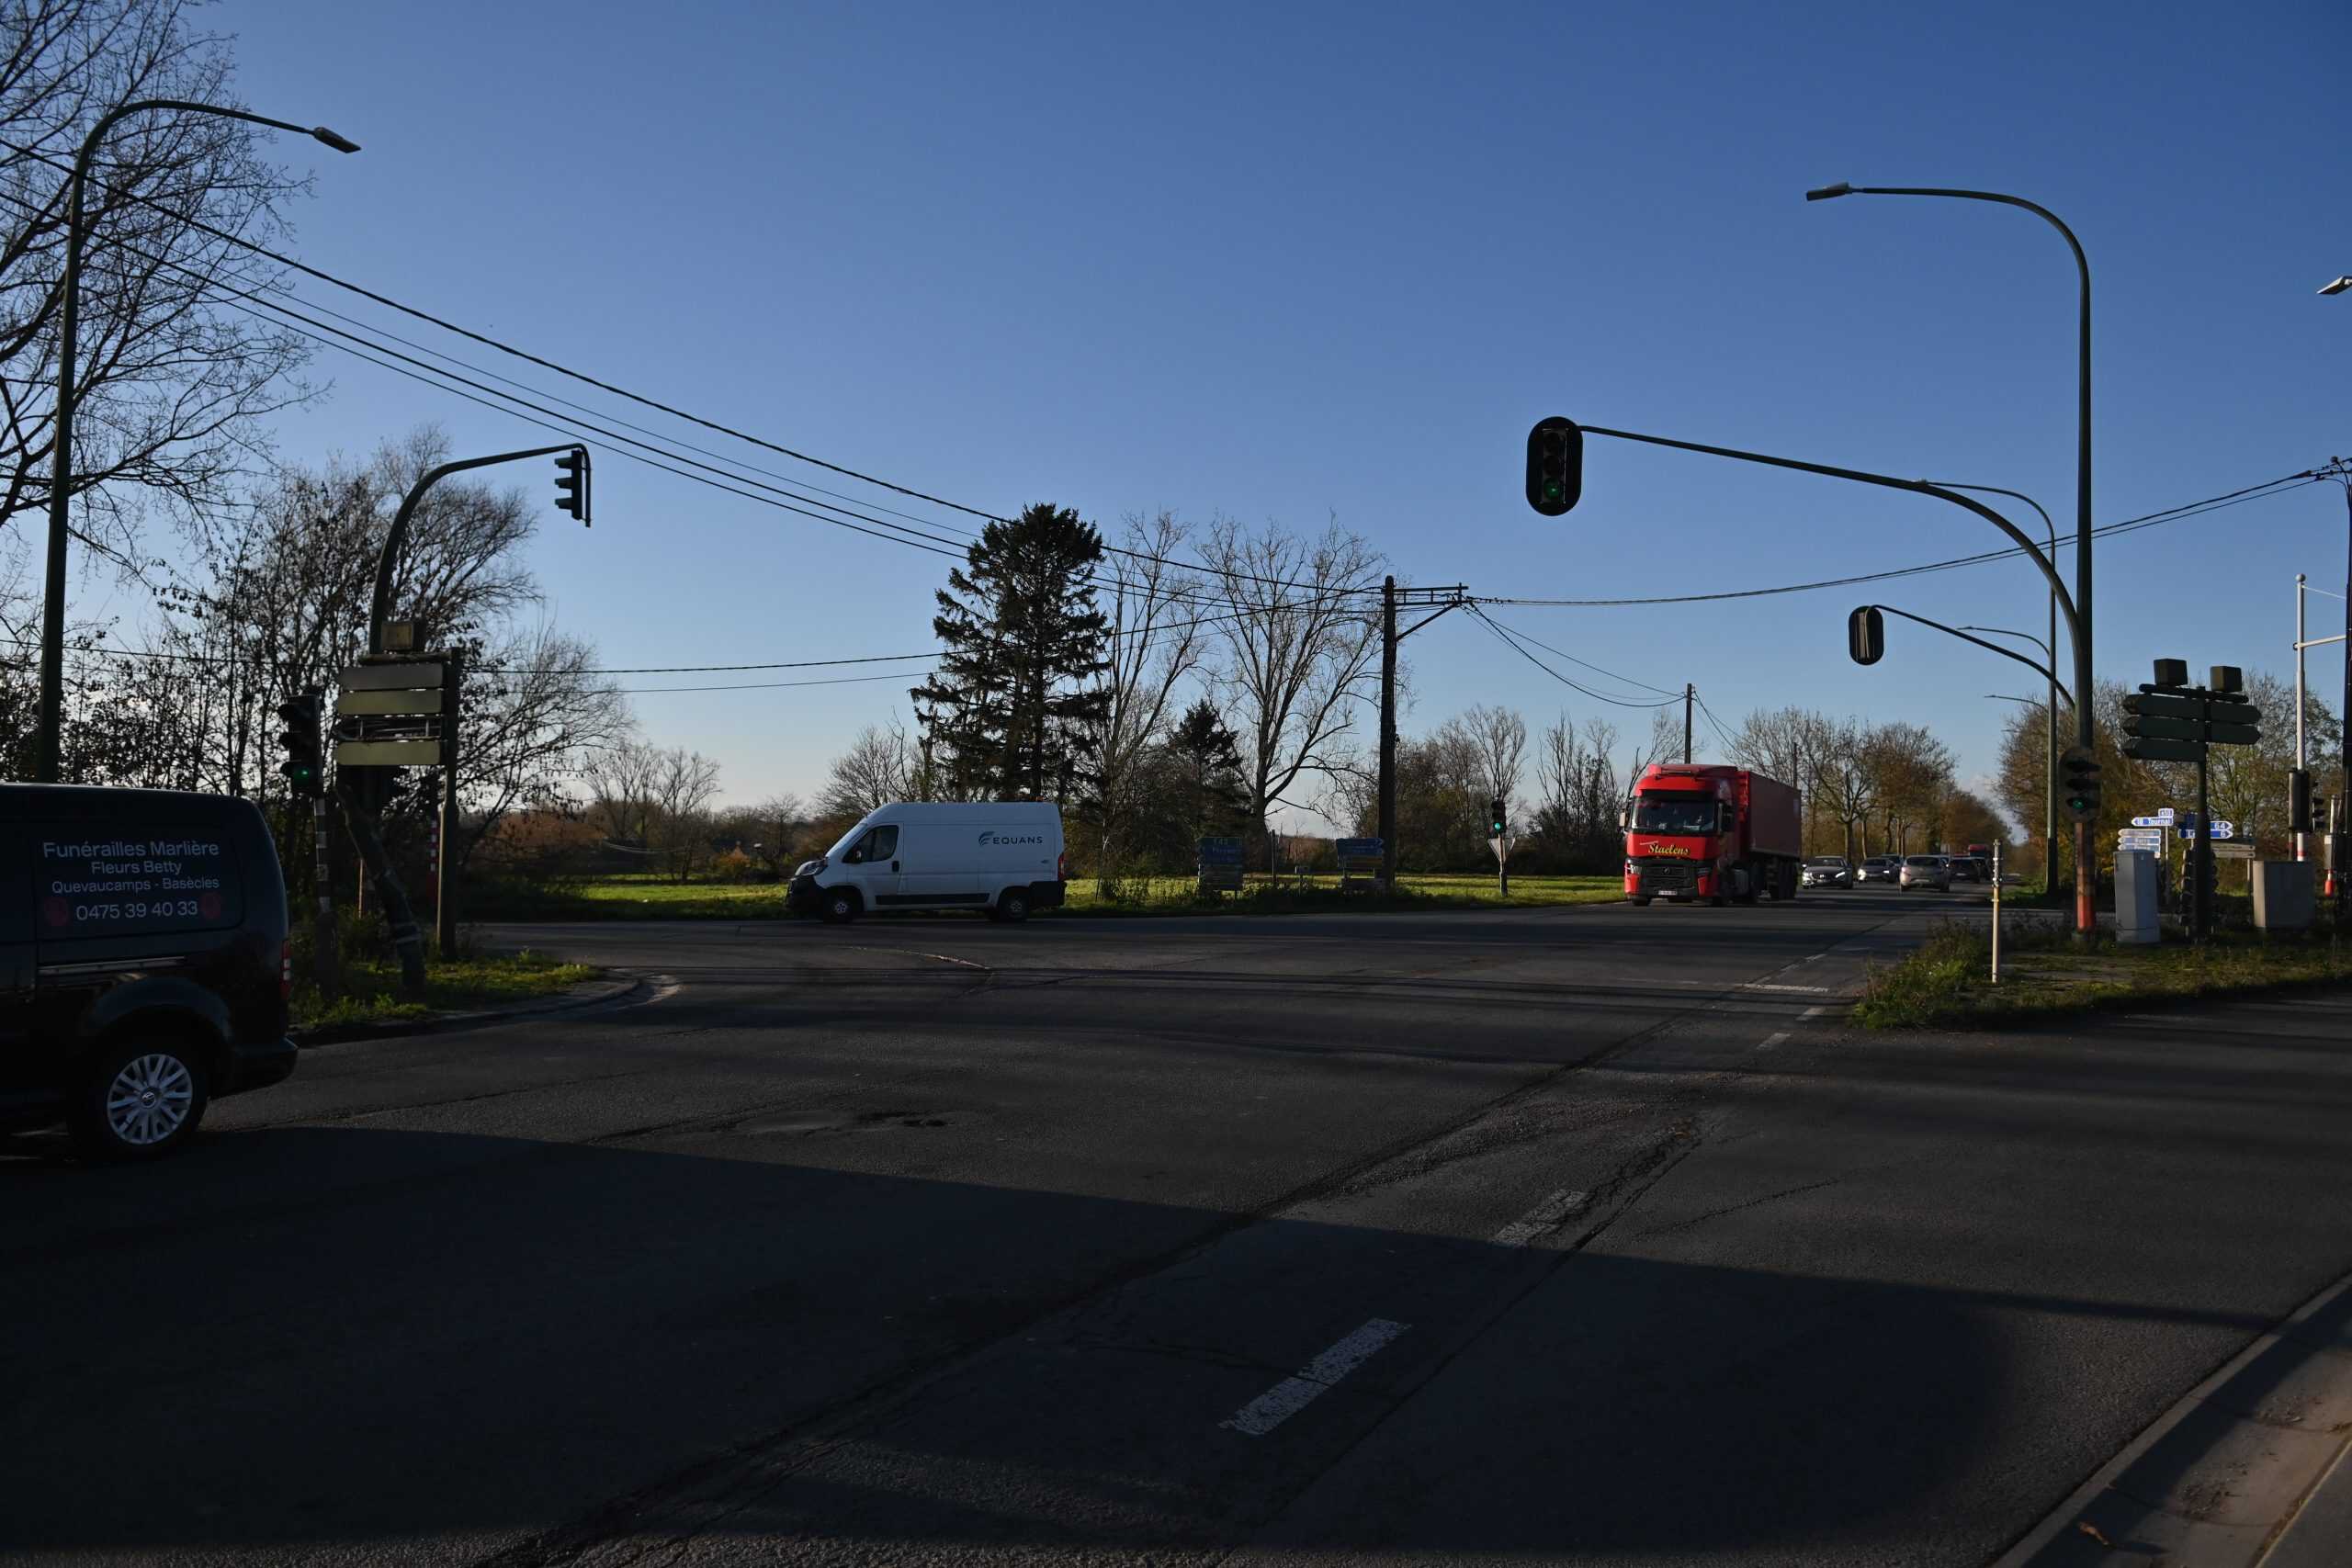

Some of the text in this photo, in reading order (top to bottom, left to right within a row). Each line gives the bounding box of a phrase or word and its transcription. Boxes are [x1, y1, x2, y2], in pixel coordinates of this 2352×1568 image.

[43, 840, 220, 858] Funérailles Marlière
[993, 837, 1044, 845] EQUANS
[91, 860, 183, 875] Fleurs Betty
[51, 880, 152, 895] Quevaucamps
[162, 876, 220, 890] Basècles
[75, 900, 198, 921] 0475 39 40 33
